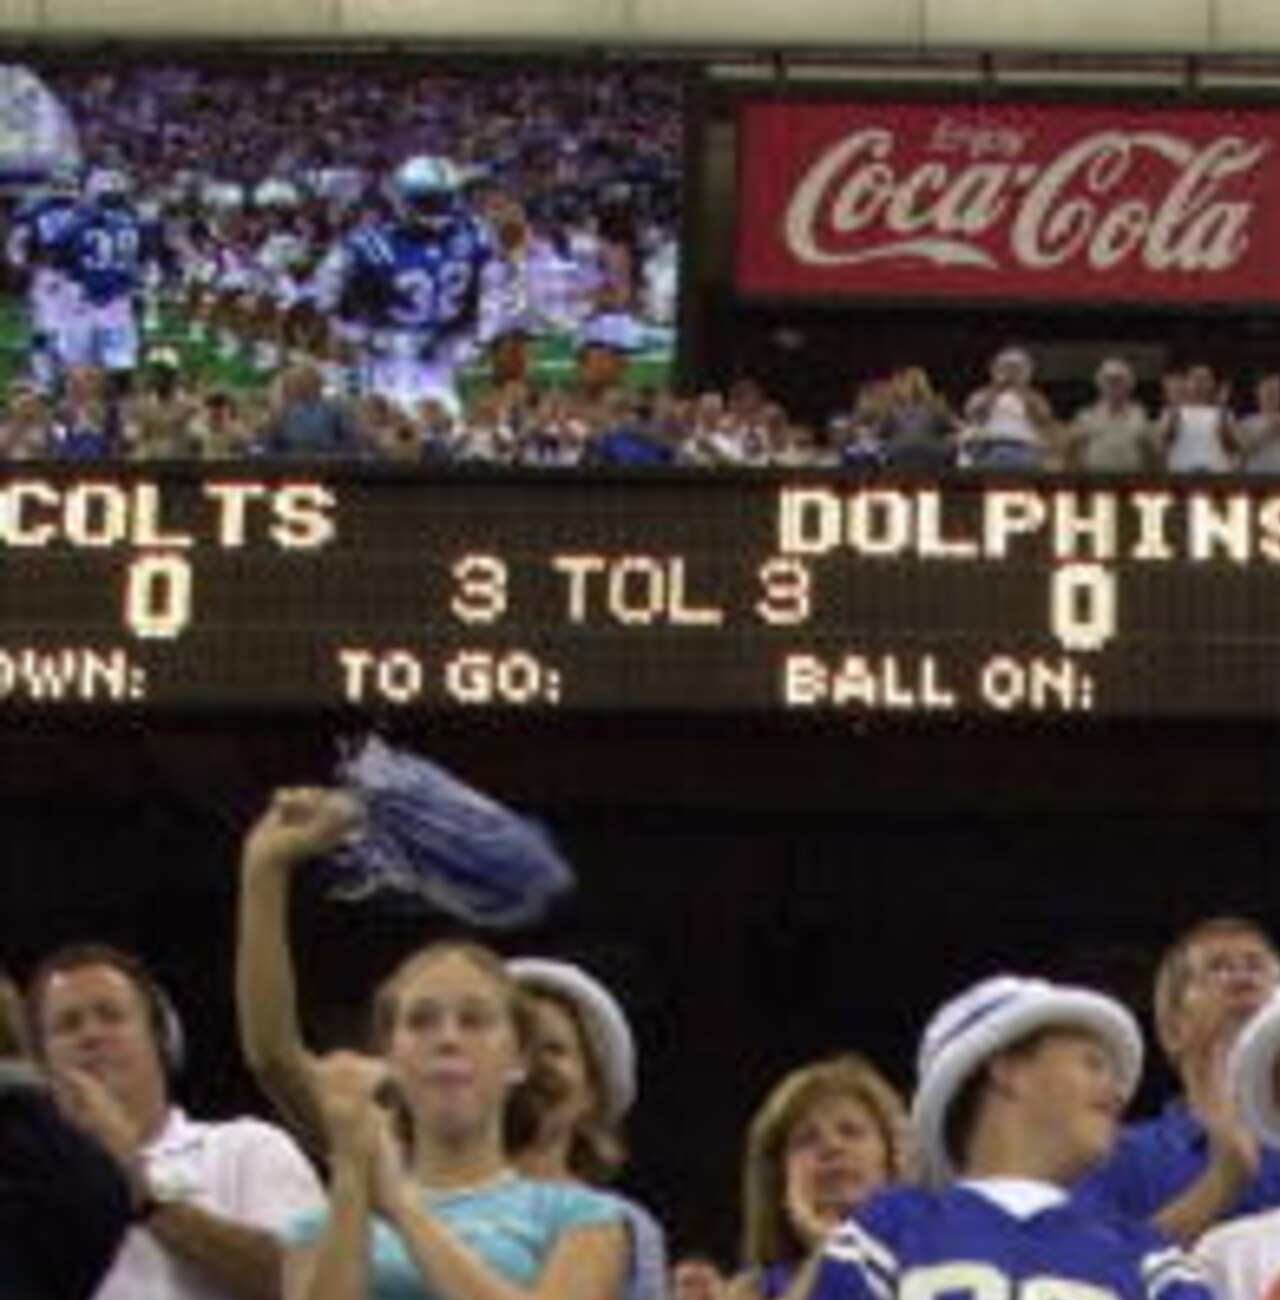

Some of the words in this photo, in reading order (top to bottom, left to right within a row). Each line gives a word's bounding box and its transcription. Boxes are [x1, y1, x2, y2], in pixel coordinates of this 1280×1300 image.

[784, 127, 1271, 272] Coca-Cola
[0, 483, 337, 549] COLTS
[553, 556, 722, 625] TOL
[337, 650, 422, 703] TO
[445, 652, 563, 704] GO:
[786, 656, 953, 707] BALL
[983, 659, 1093, 710] ON:
